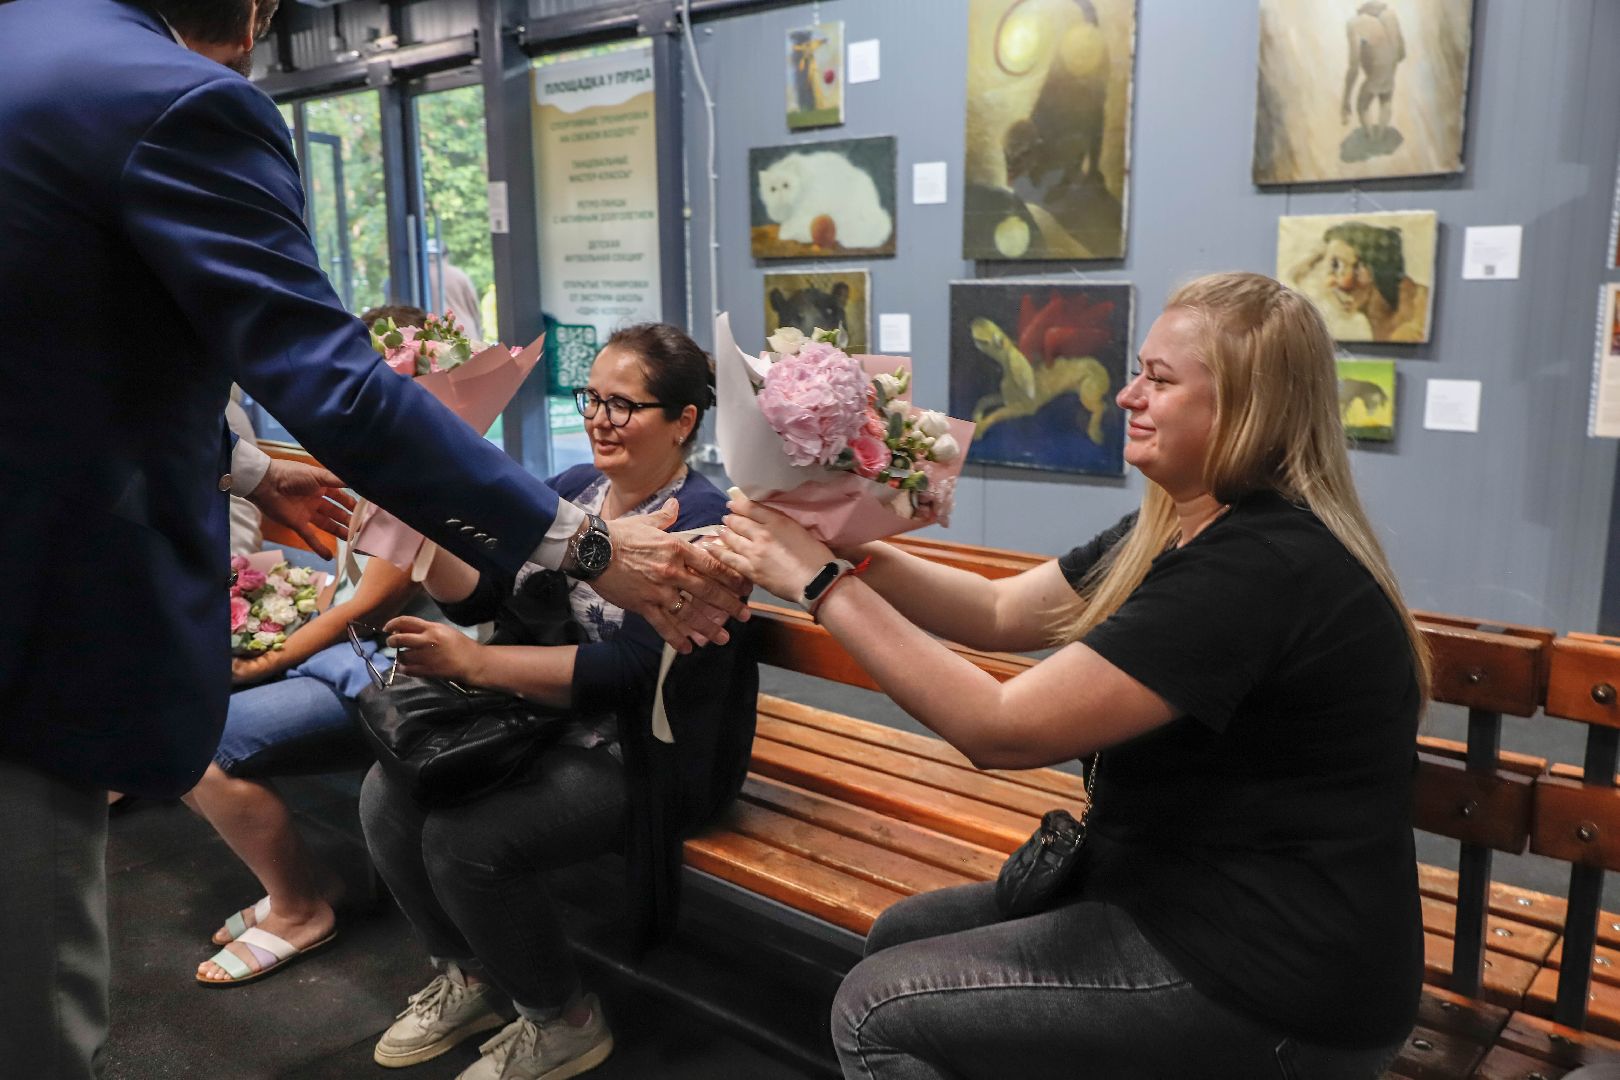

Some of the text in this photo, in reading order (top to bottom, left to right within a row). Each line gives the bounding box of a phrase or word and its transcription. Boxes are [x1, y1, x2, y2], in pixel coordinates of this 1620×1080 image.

[545, 67, 651, 94] ПЛОЩАДКА У ПРУДА
